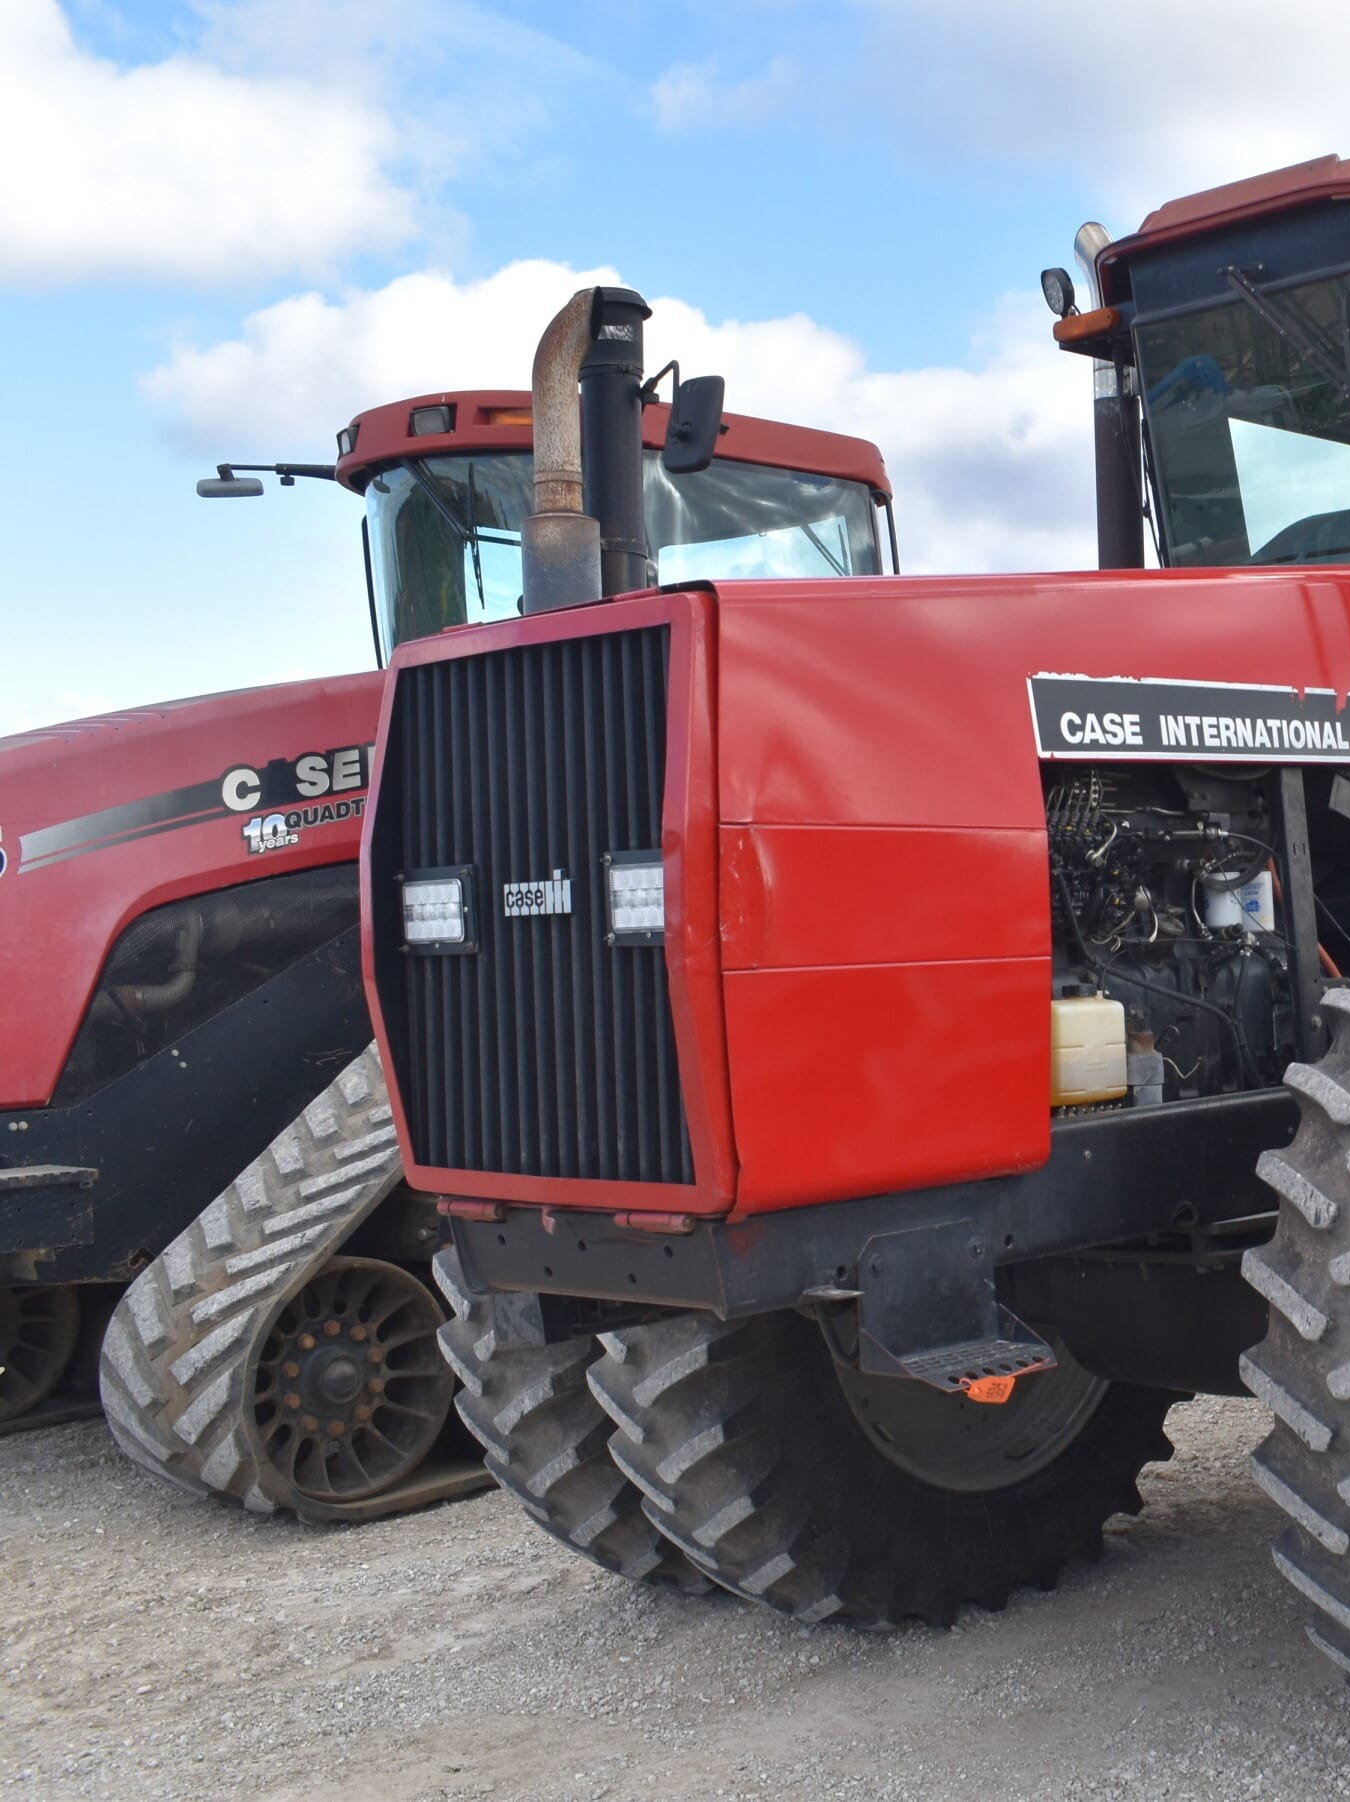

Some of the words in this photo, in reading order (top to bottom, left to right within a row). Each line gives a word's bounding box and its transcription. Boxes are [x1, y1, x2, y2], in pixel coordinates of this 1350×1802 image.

[1060, 711, 1143, 746] CASE
[1160, 714, 1349, 750] INTERNATIONAL
[222, 749, 361, 811] CSE
[243, 813, 288, 852] 10
[284, 798, 368, 829] QUADT
[258, 833, 299, 853] years
